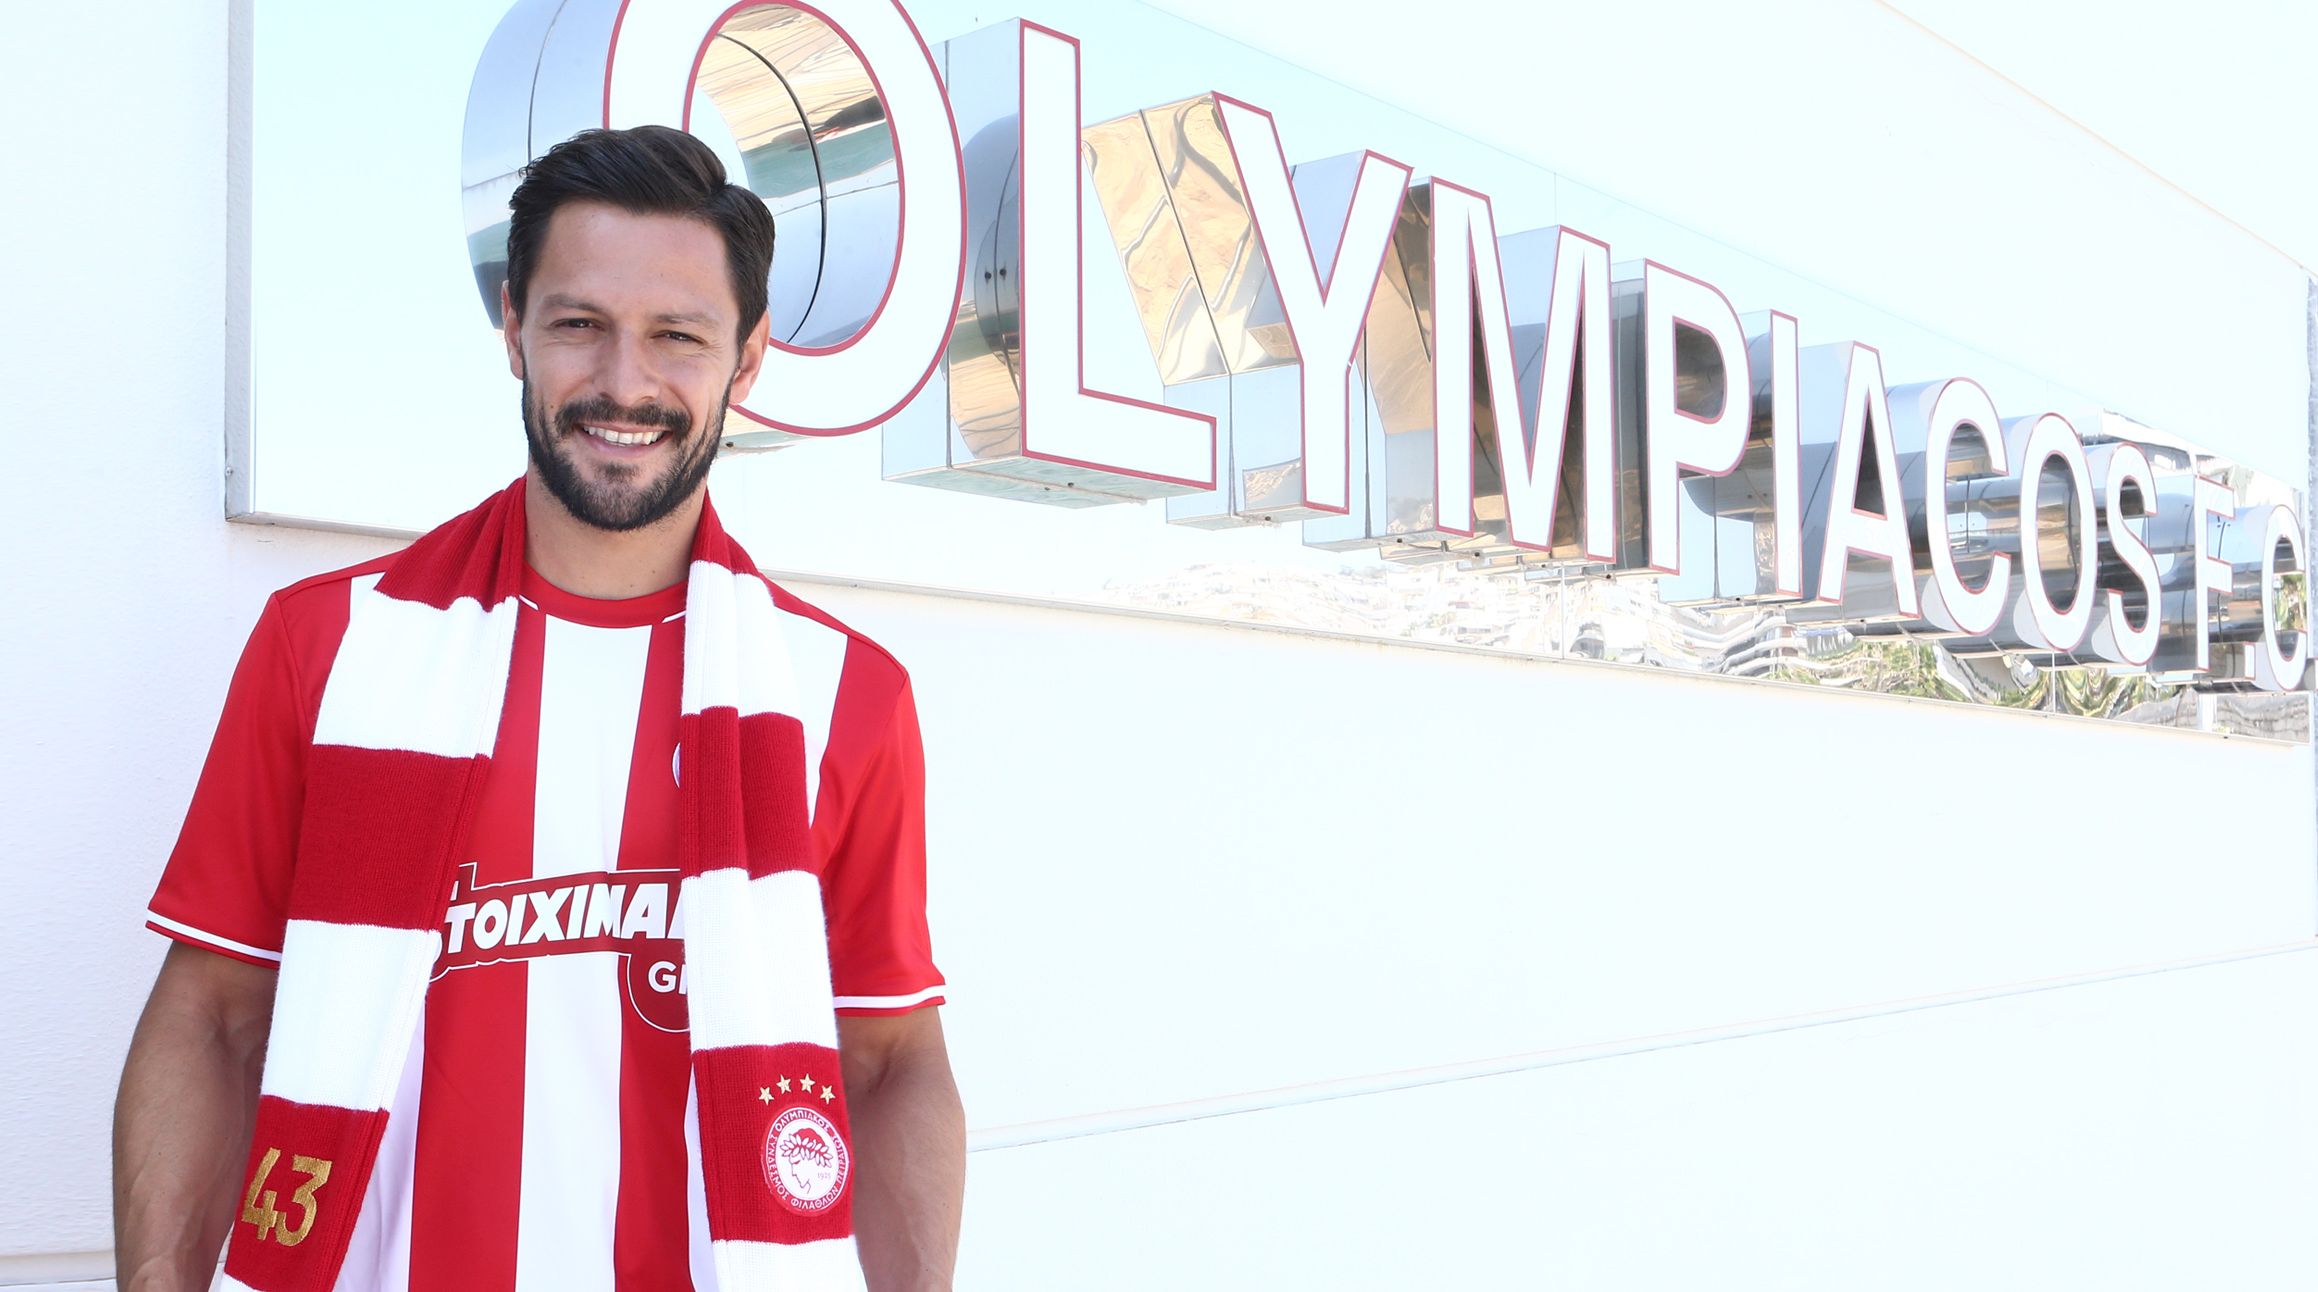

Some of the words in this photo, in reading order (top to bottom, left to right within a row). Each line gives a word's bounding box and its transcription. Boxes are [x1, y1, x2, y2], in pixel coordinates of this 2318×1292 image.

[602, 0, 2162, 667] OLYMPIACOS
[444, 881, 685, 954] TOIXIMA
[241, 1147, 333, 1247] 43
